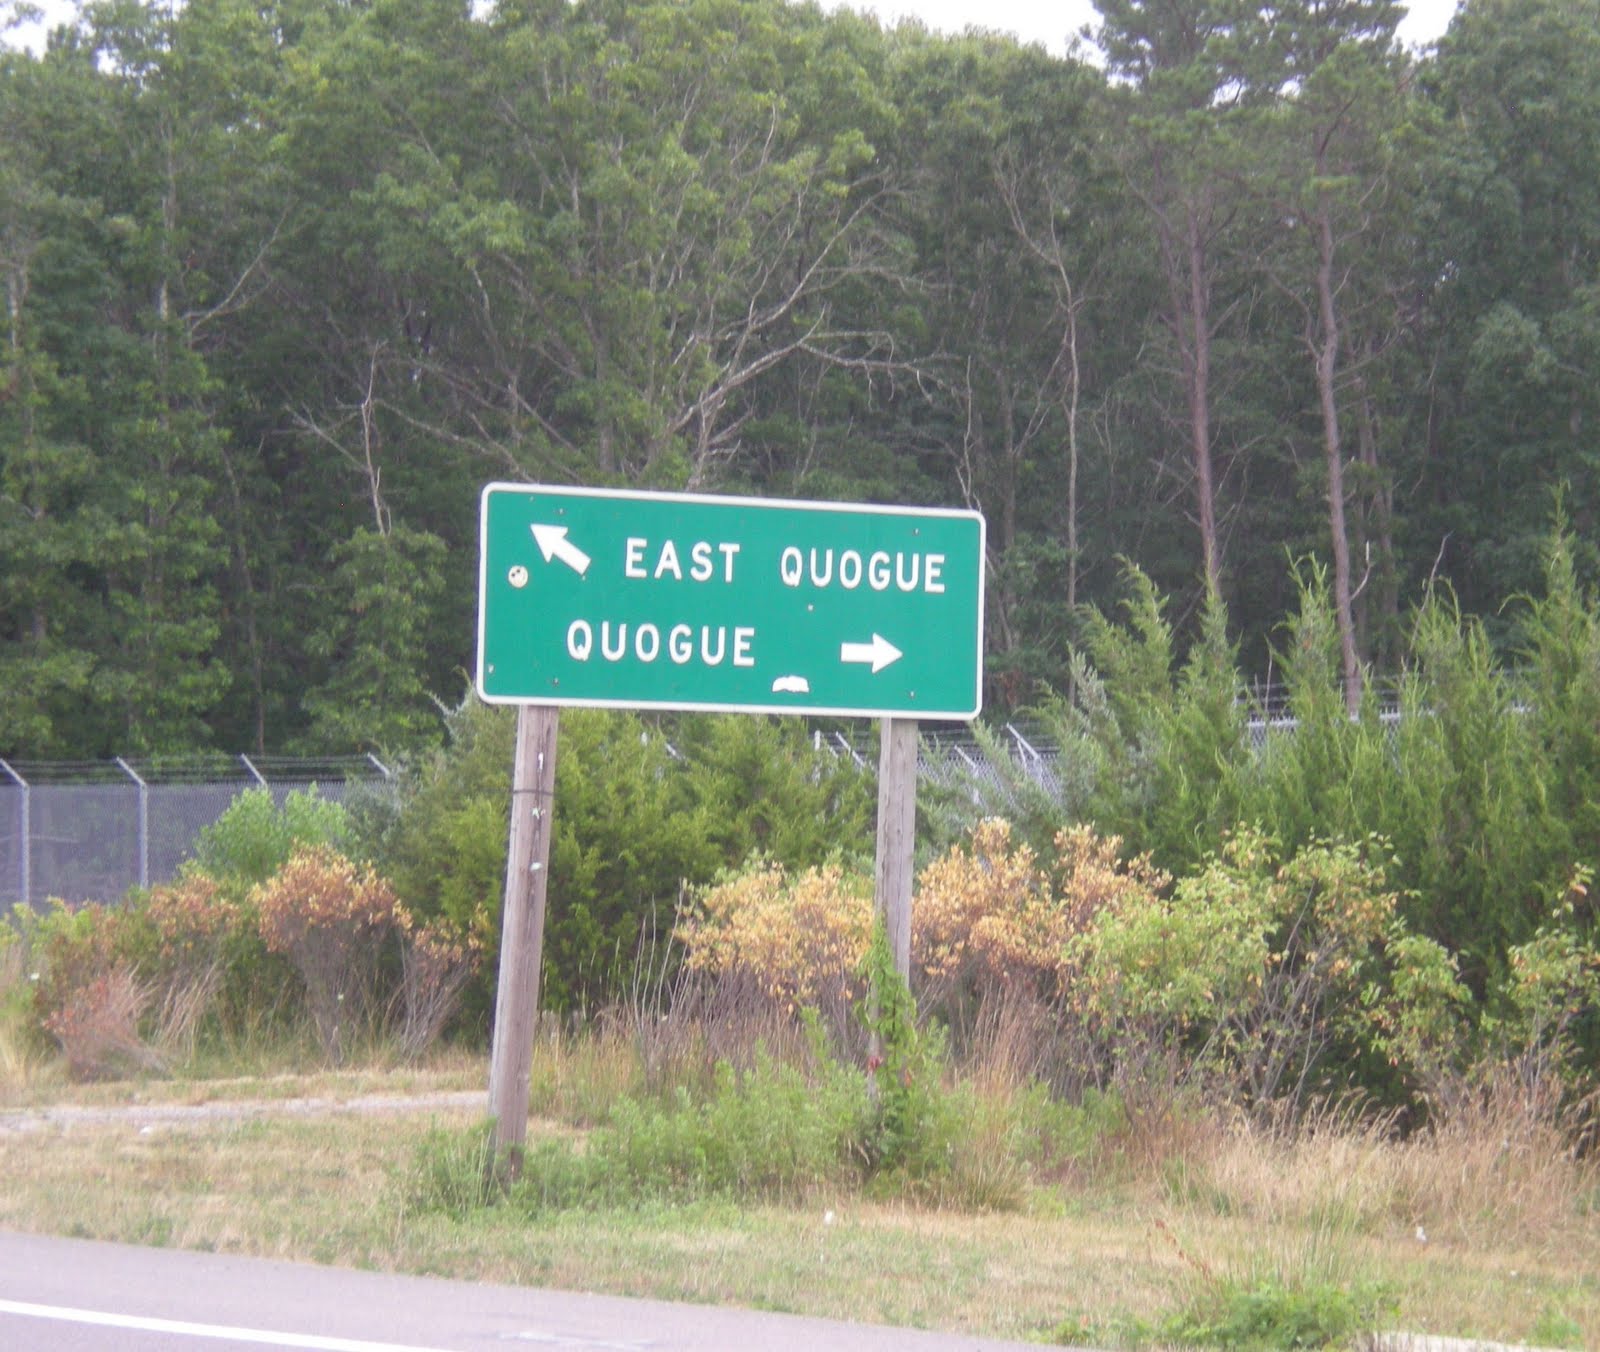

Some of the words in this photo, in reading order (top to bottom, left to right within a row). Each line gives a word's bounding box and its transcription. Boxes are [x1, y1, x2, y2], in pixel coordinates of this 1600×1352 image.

[624, 537, 741, 584] EAST
[779, 546, 947, 594] QUOGUE
[566, 619, 755, 668] QUOGUE
